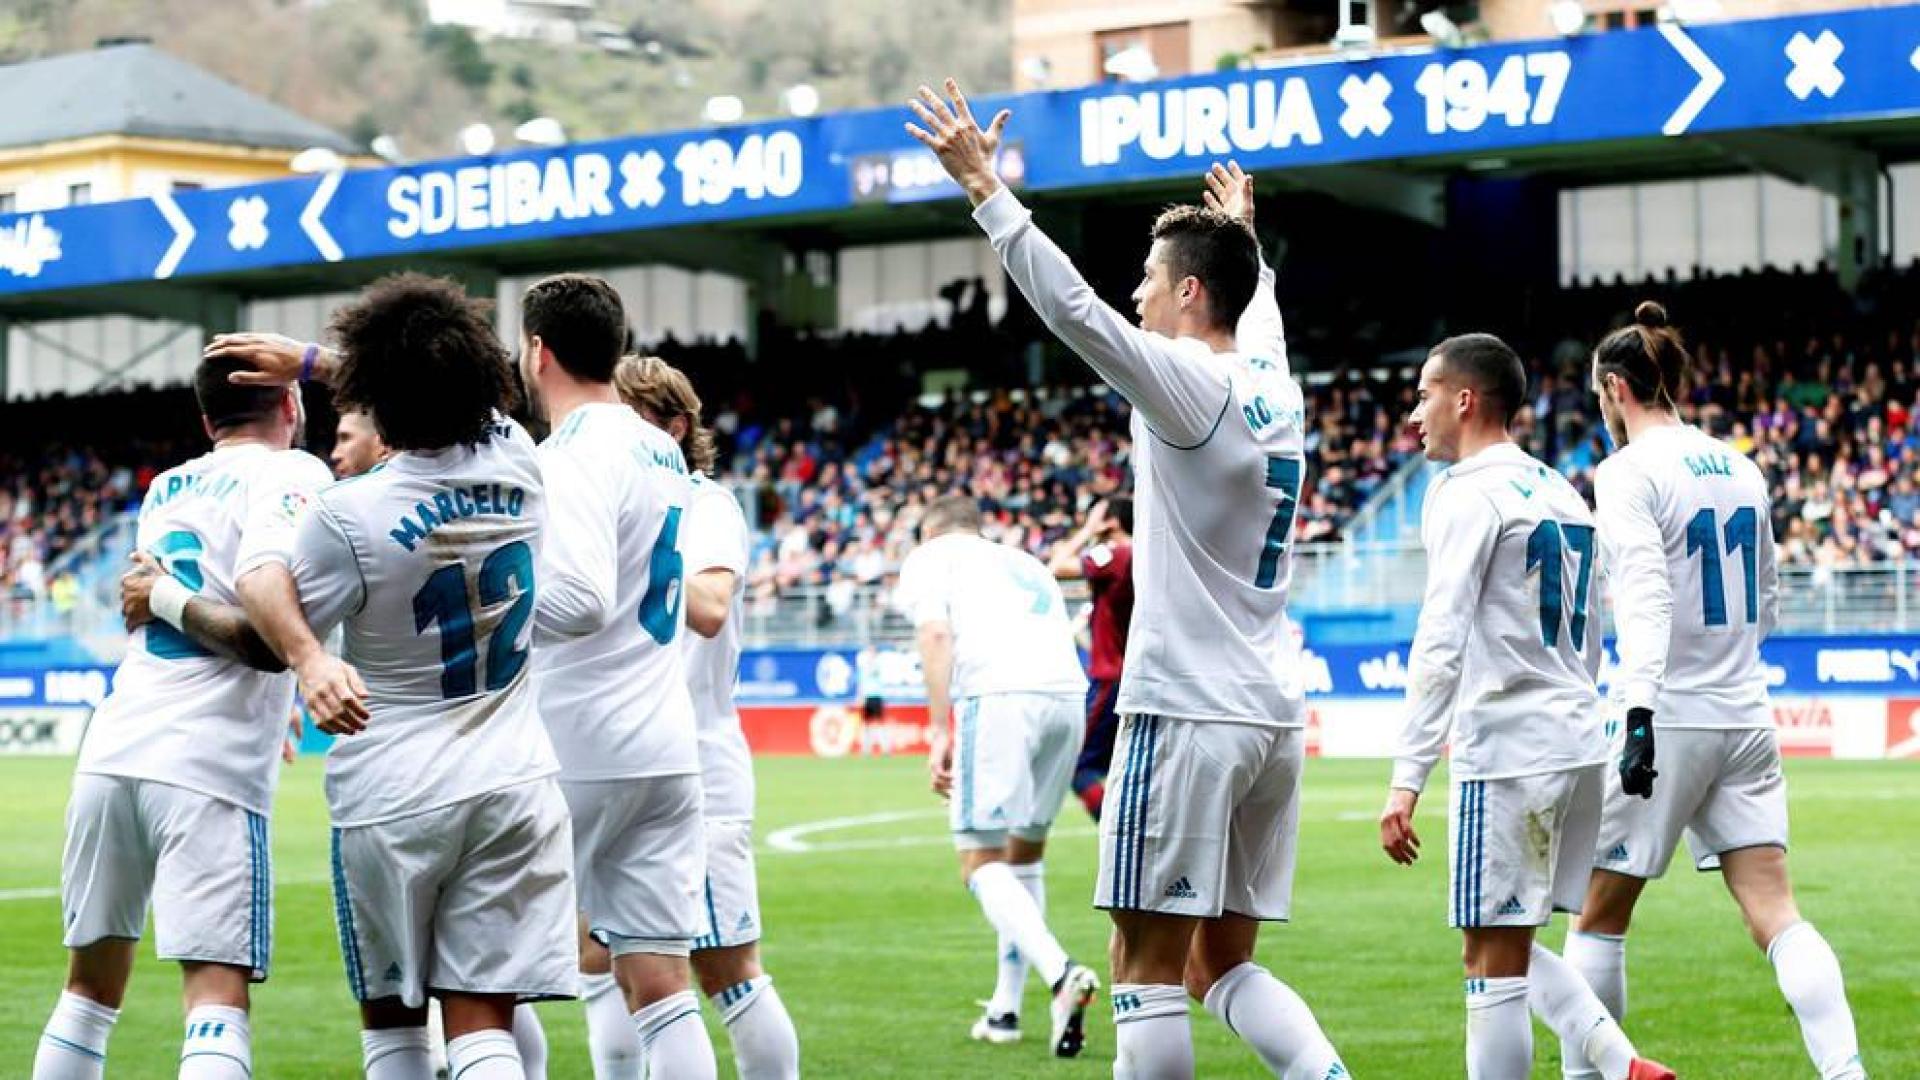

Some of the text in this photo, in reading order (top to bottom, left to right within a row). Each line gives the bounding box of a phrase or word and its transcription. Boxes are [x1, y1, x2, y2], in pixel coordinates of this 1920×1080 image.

[1080, 78, 1322, 167] IPURUA
[1414, 51, 1572, 134] 1947
[387, 153, 613, 239] SDEIBAR
[674, 130, 802, 207] 1940
[390, 484, 524, 552] MARCELO
[638, 505, 684, 646] 6
[1254, 457, 1300, 588] 7
[1686, 506, 1758, 626] 11
[413, 540, 534, 700] 12
[1525, 519, 1596, 653] 17
